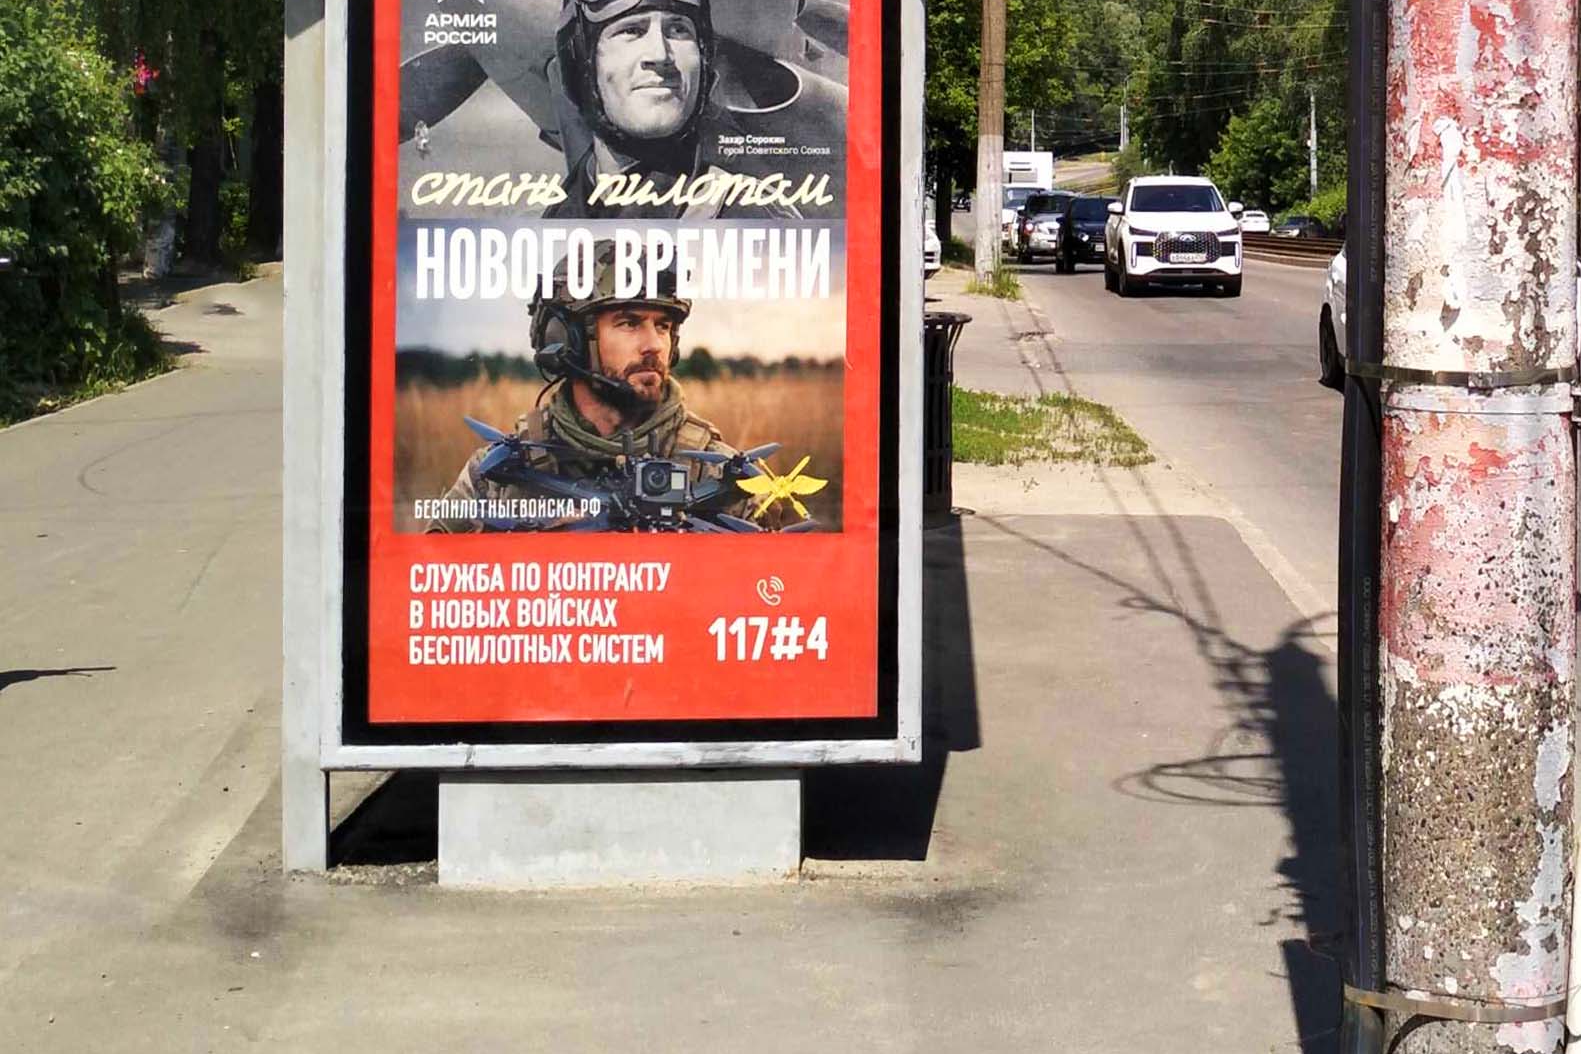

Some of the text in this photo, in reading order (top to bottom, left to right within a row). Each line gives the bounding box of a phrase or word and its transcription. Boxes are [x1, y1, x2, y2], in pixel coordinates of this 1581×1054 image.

[425, 13, 497, 27] АРМИЯ
[424, 31, 497, 45] РОССИИ
[718, 146, 831, 157] Герой Советского Союза
[746, 135, 785, 145] Сорокин
[411, 171, 569, 206] стань
[416, 227, 831, 300] НОВОГО ВРЕМЕНИ
[414, 496, 601, 519] БЕСПИЛОТНЫЕВОЙСКА.РФ
[410, 562, 671, 593] СЛУЖБА ПО КОНТРАКТУ
[410, 593, 617, 629] В НОВЫХ ВОЙСКАХ
[409, 634, 664, 665] БЕСПИЛОТНЫХ СИСТЕМ
[708, 616, 829, 661] 117#4
